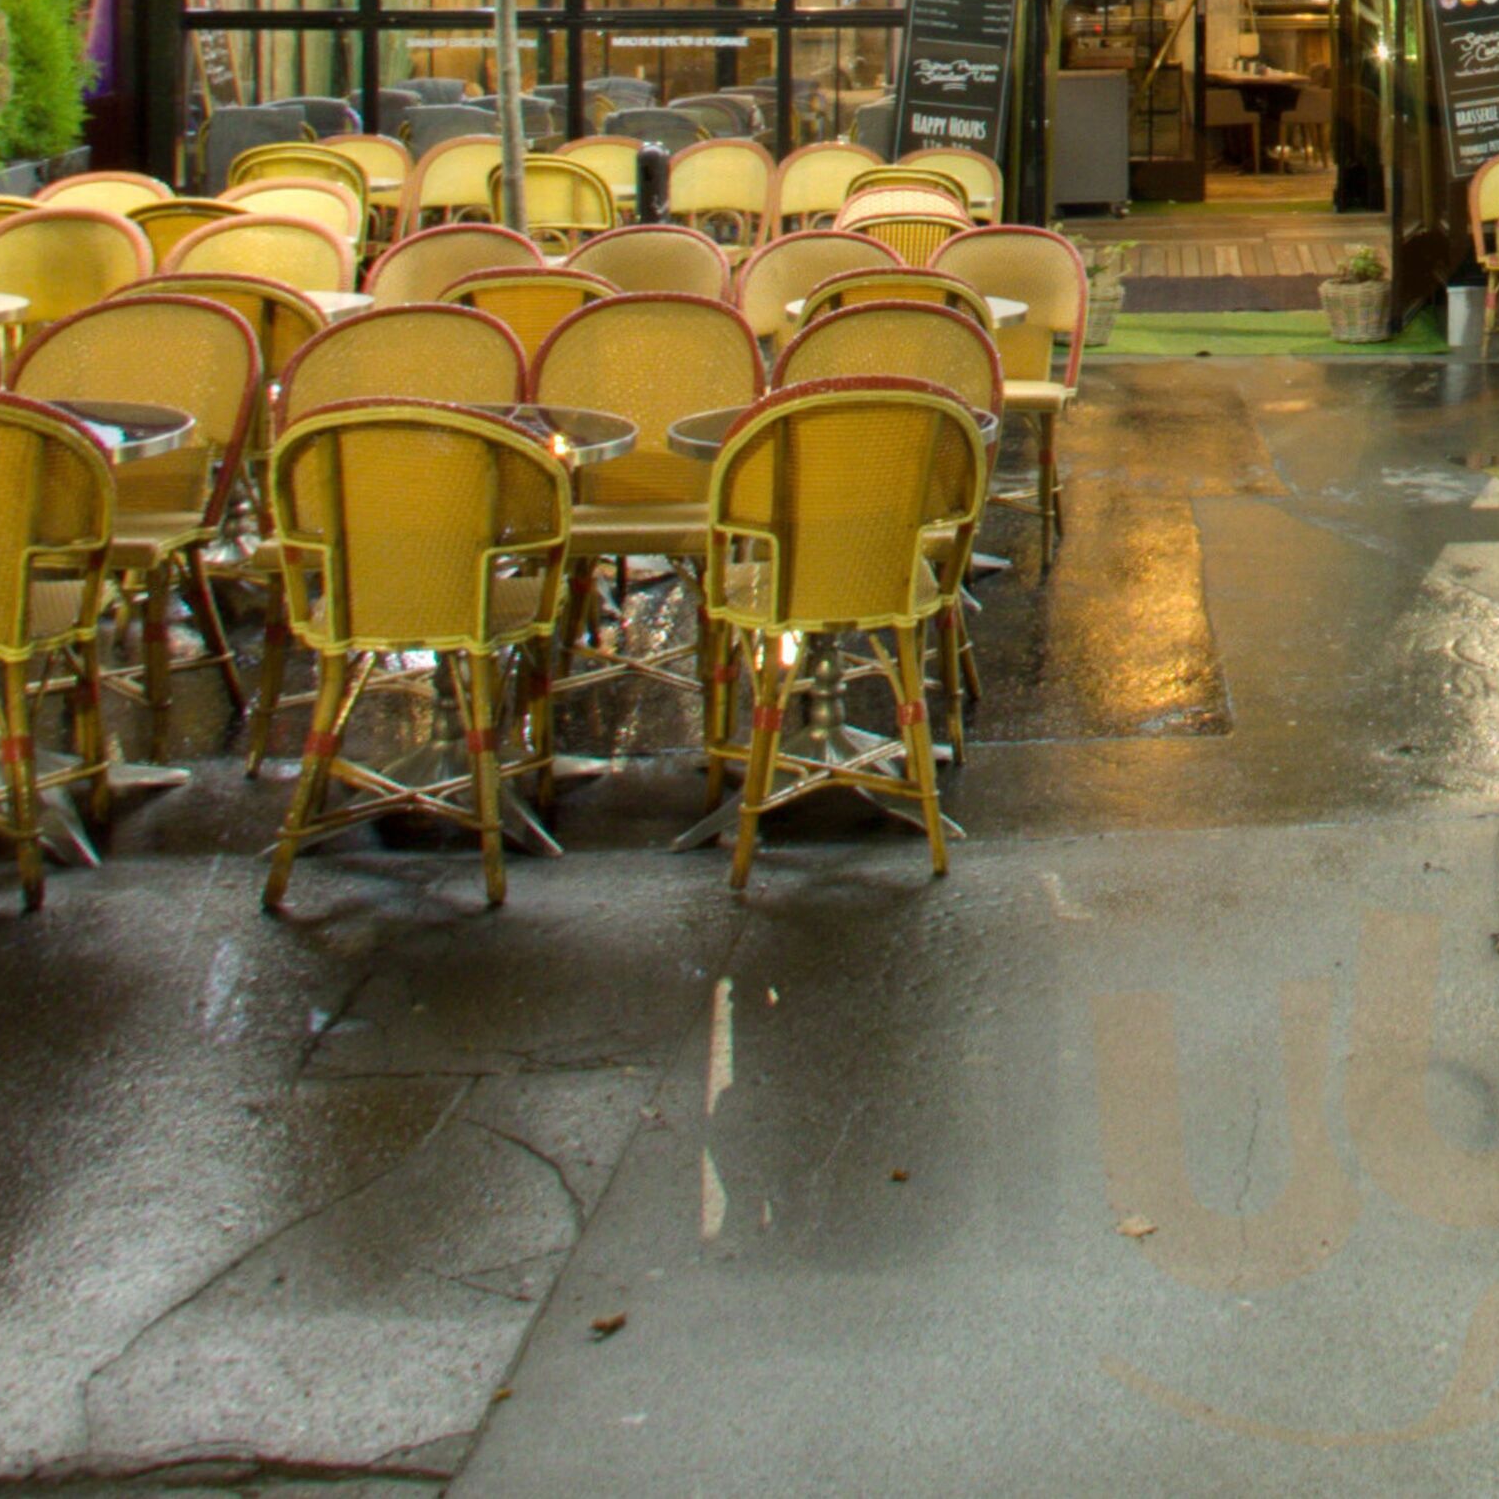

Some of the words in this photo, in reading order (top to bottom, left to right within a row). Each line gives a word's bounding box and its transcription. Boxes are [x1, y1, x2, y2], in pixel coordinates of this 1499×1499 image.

[911, 112, 947, 136] HAPPY
[948, 115, 987, 140] HOURS
[1454, 104, 1498, 127] BRASSERIE
